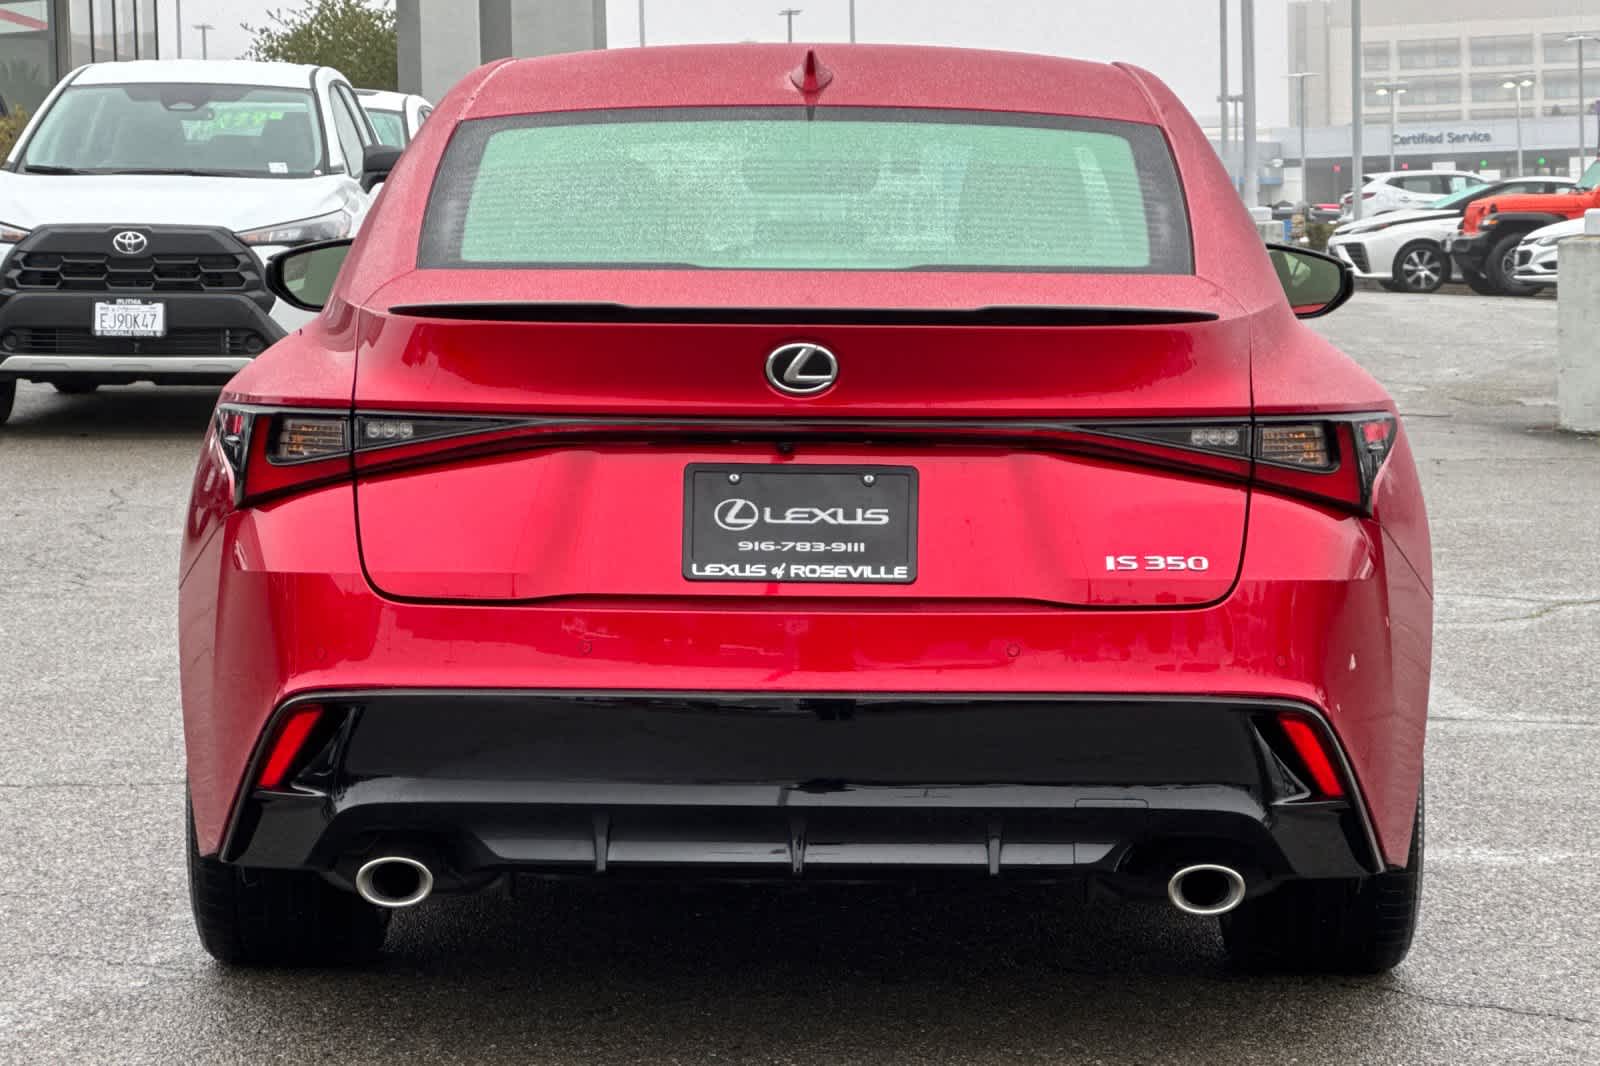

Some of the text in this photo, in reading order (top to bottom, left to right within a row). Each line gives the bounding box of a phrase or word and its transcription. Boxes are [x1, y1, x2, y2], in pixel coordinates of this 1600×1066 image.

[1392, 131, 1491, 145] Certified Service
[764, 507, 889, 525] LEXUS
[737, 541, 866, 553] 916-783-9111
[692, 563, 908, 579] LEXUS of ROSEVILLE
[1105, 555, 1209, 571] IS 350
